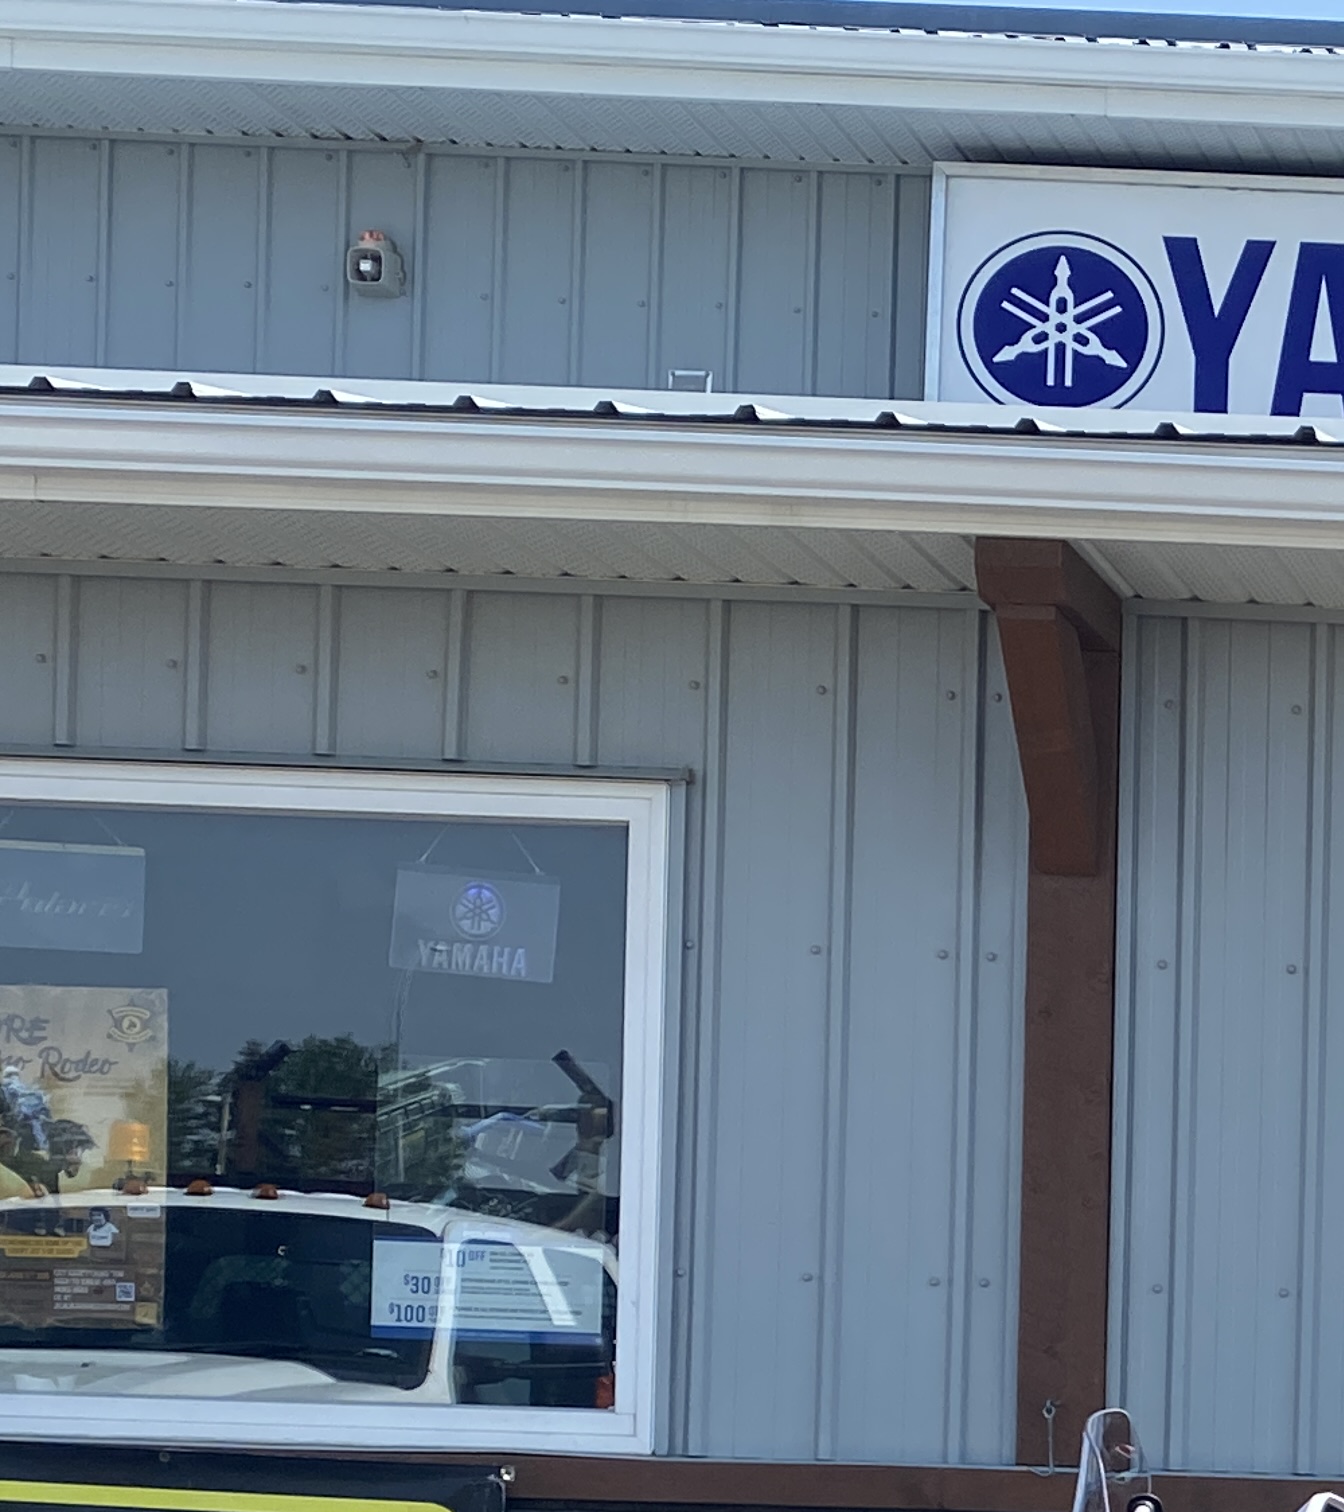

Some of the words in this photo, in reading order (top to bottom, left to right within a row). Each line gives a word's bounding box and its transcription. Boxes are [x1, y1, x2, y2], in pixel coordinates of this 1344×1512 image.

[418, 939, 527, 977] YAMAHA
[38, 1046, 119, 1082] Rodeo
[403, 1274, 431, 1294] $30
[388, 1302, 426, 1323] $100
